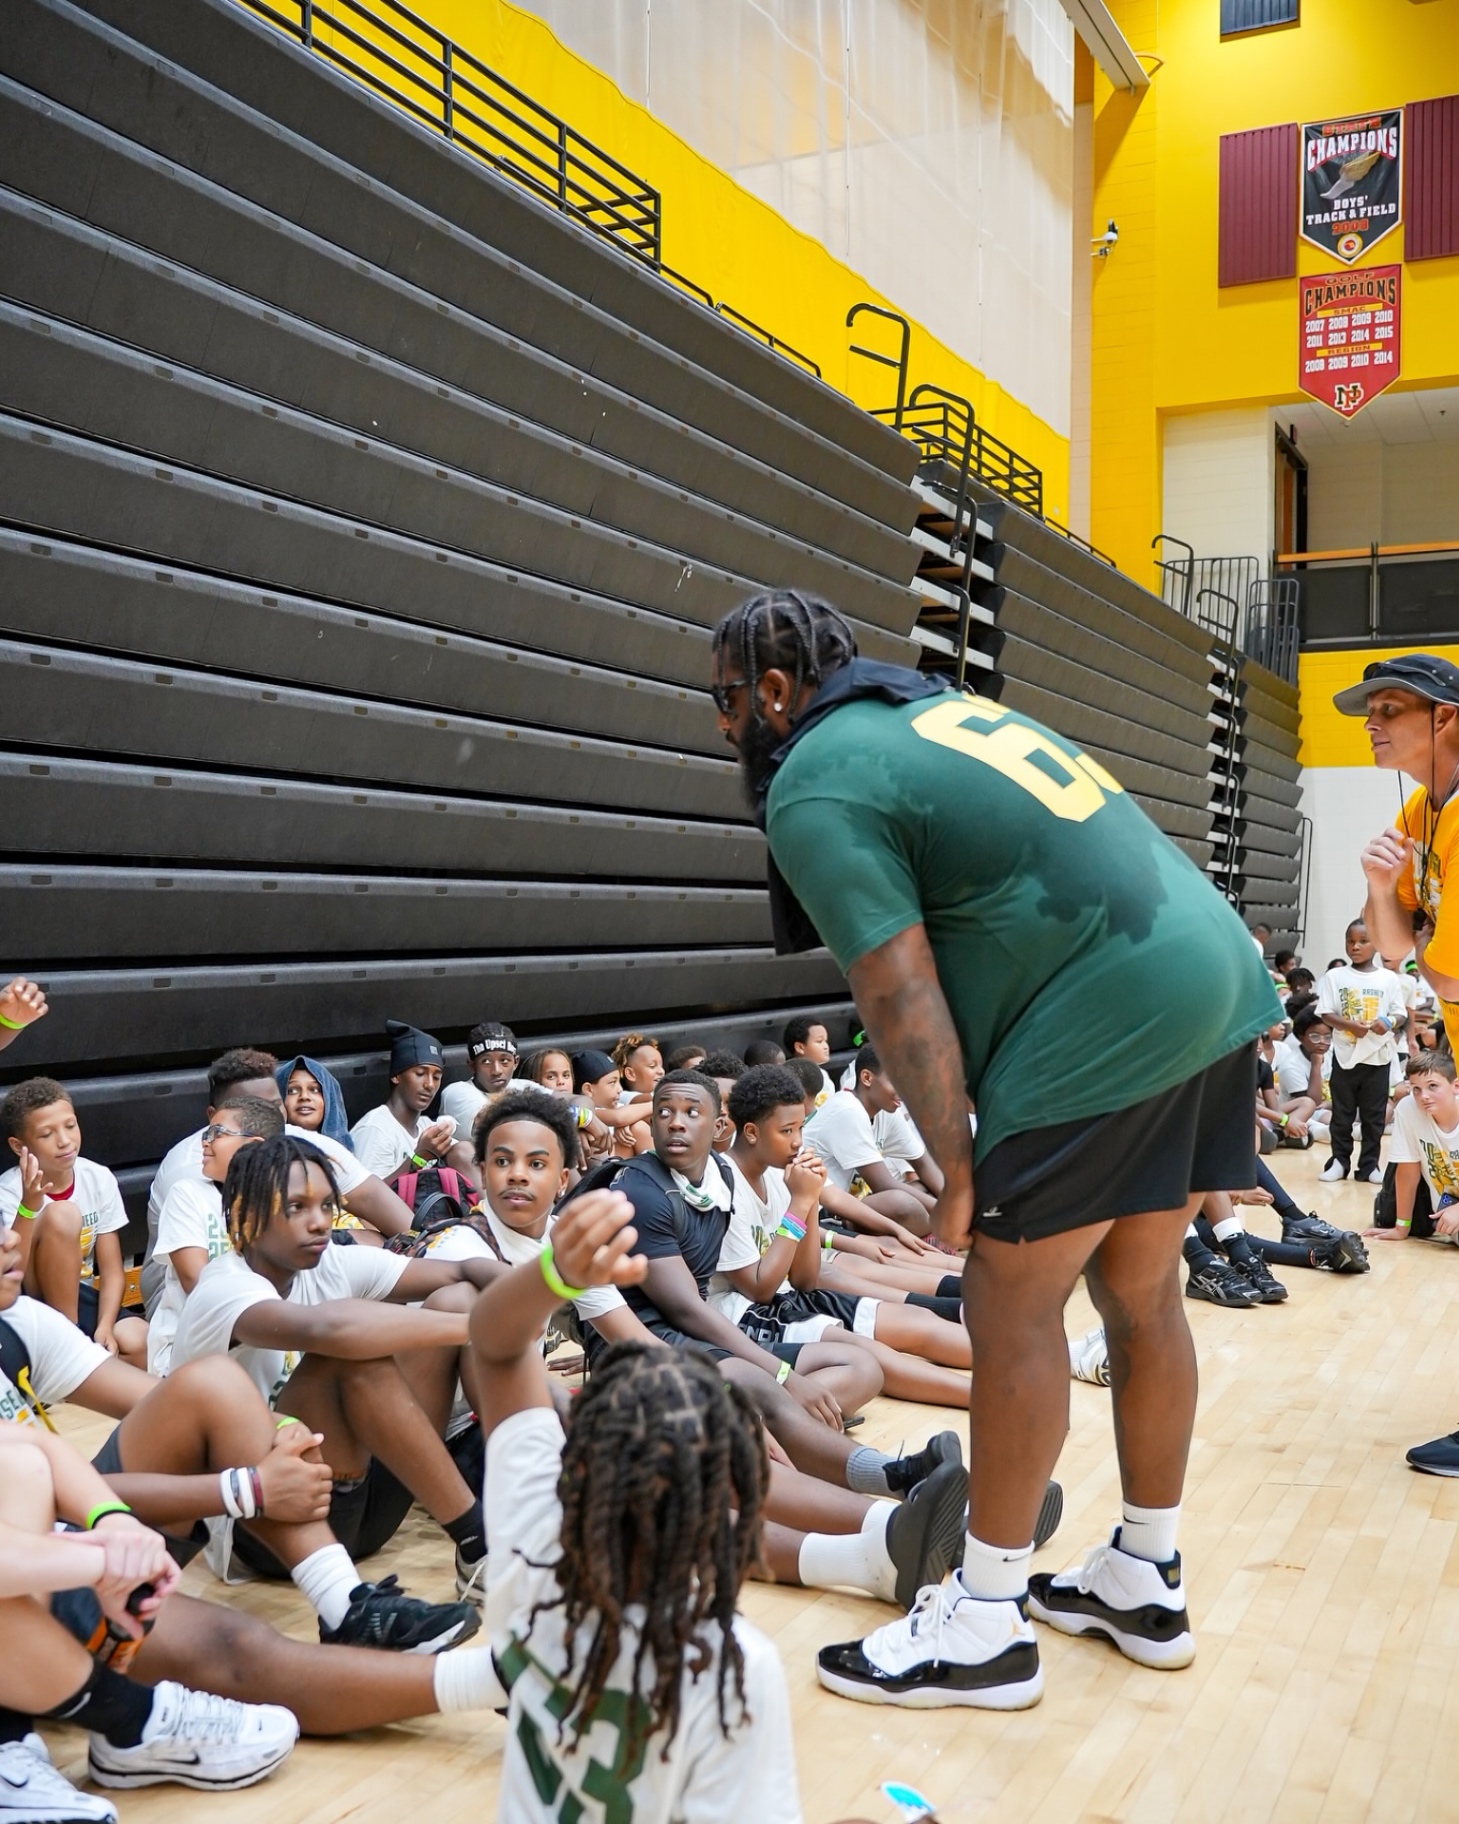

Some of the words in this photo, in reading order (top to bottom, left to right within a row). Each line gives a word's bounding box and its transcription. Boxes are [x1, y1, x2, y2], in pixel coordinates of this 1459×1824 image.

[1307, 126, 1397, 172] CHAMPIONS
[1306, 209, 1347, 225] TRACK
[1349, 209, 1357, 219] &
[1359, 203, 1396, 218] FIELD
[1333, 195, 1369, 211] BOYS'
[1325, 271, 1375, 285] GOLF
[1304, 277, 1397, 317] CHAMPIONS
[1305, 319, 1325, 333] 2007
[1351, 312, 1371, 327] 2009
[1374, 310, 1393, 323] 2010
[1306, 334, 1323, 348] 2011
[1328, 331, 1346, 346] 2013
[1351, 328, 1369, 343] 2014
[1374, 325, 1393, 339] 2015
[1327, 345, 1370, 355] REGION
[1351, 353, 1369, 367] 2010
[1373, 351, 1393, 365] 2014
